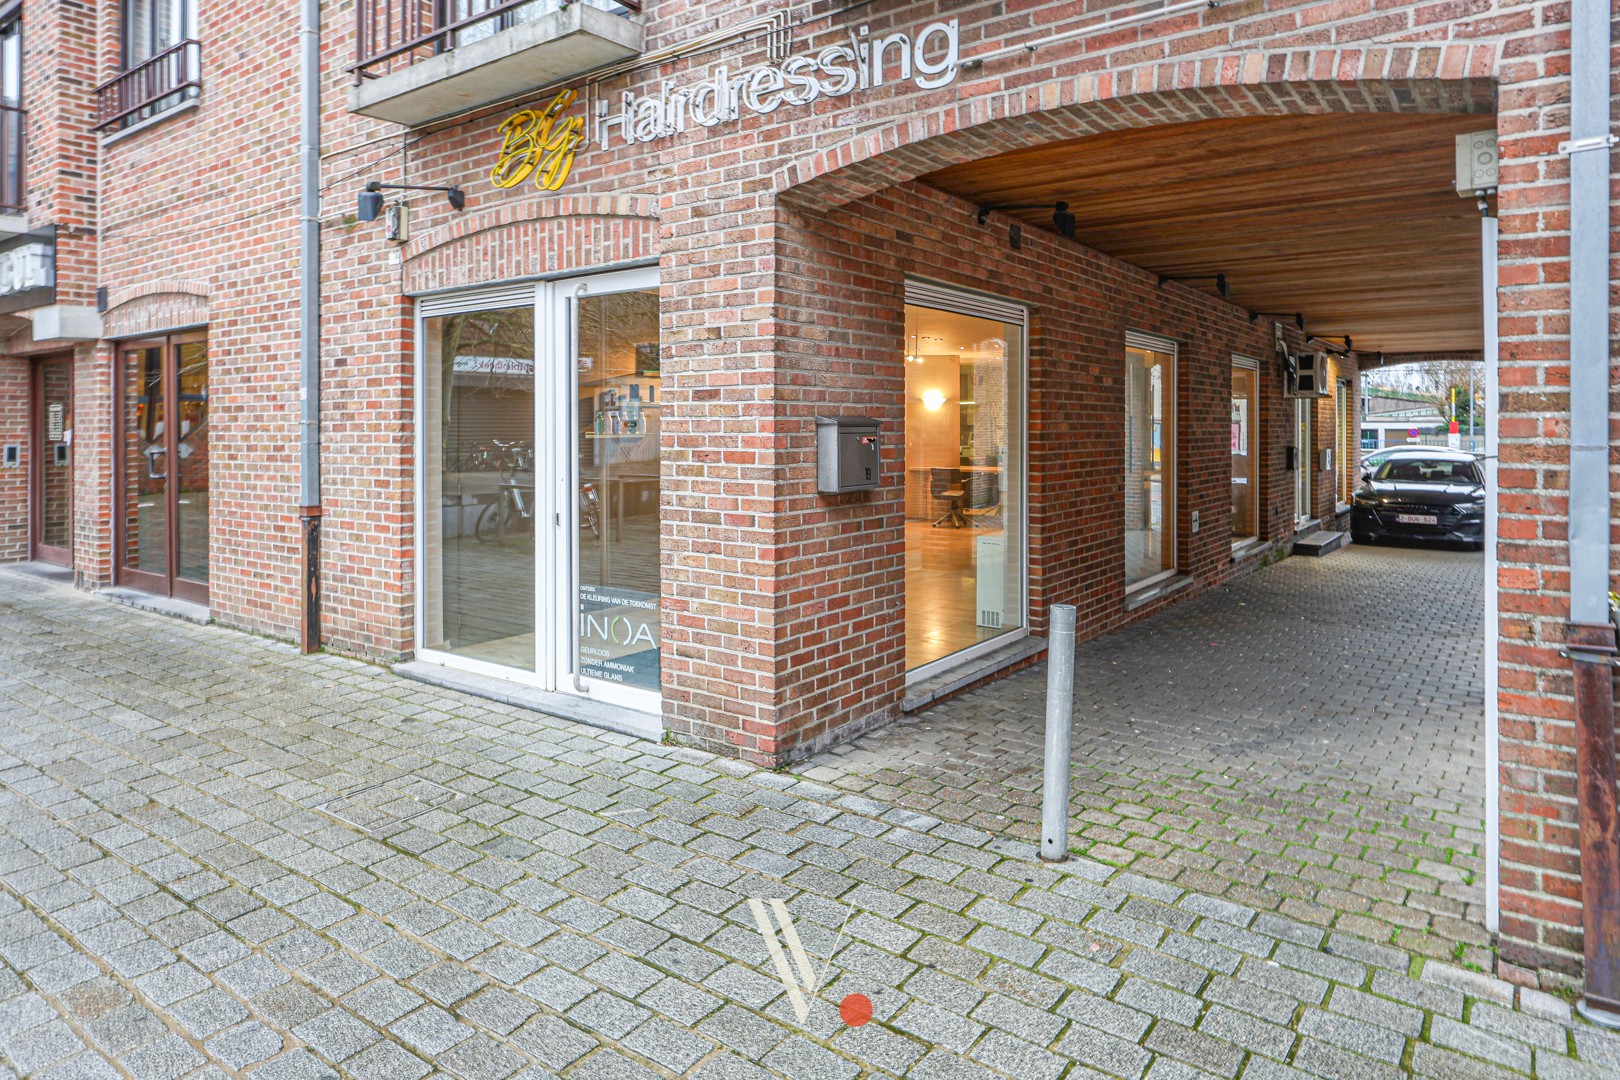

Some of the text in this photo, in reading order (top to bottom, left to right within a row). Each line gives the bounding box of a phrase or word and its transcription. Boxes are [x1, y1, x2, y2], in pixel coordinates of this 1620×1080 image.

[594, 18, 960, 152] Hairdressing
[864, 467, 872, 481] 19
[580, 585, 596, 593] ONTDEK
[587, 594, 611, 604] KLEURING
[610, 596, 622, 605] VAN
[621, 598, 629, 606] DE
[629, 599, 657, 610] TOEKOMST
[580, 646, 610, 657] GEURLOOS
[580, 657, 635, 673] ZONDER AMMONIAK
[580, 667, 623, 682] ULTIEME GLANS
